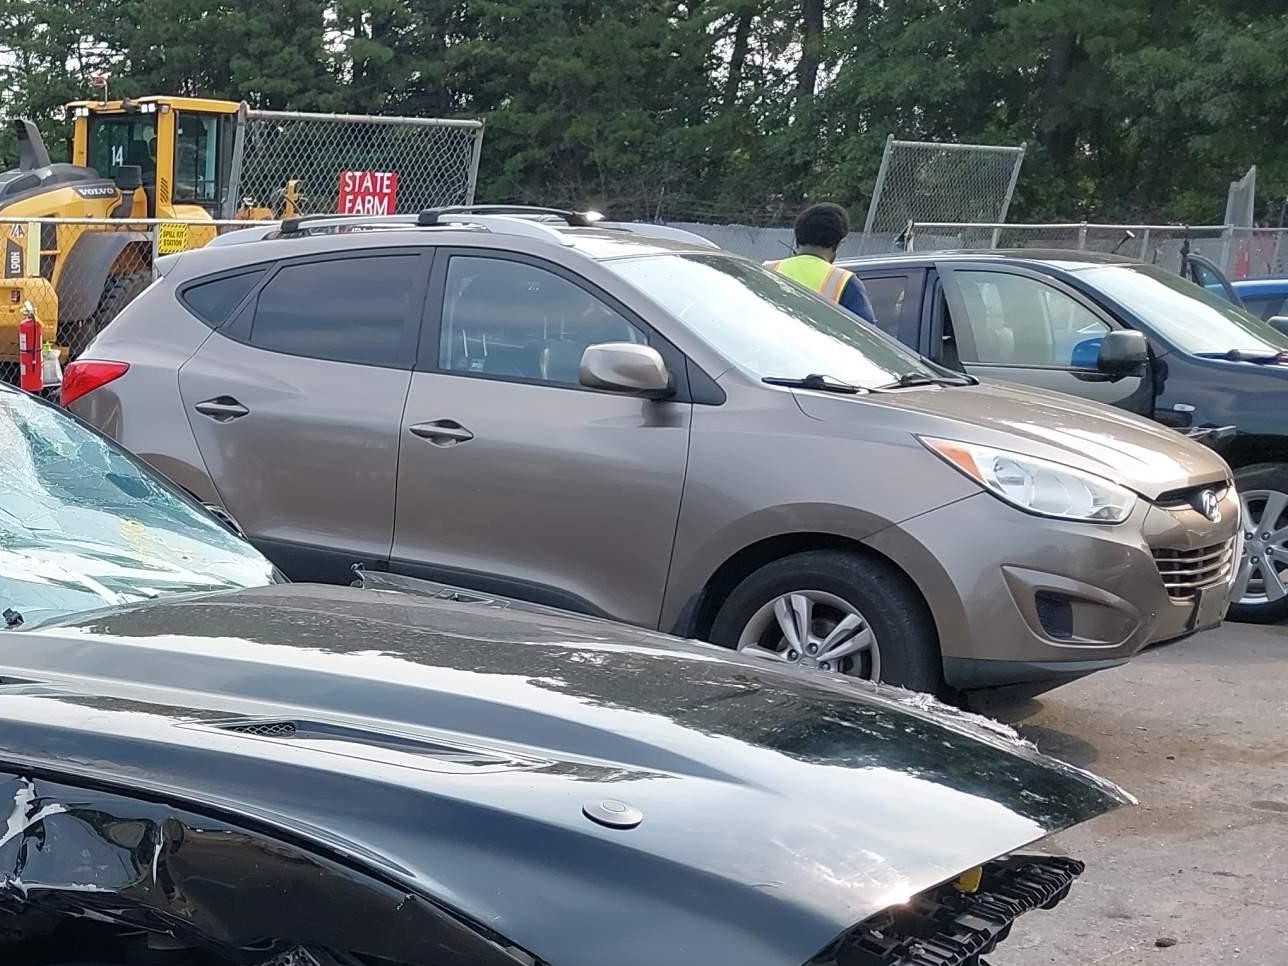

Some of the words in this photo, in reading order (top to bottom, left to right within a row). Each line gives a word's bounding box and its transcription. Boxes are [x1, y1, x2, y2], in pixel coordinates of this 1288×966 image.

[112, 145, 123, 167] 14
[78, 187, 114, 195] VOLVO
[344, 171, 392, 193] STATE
[344, 194, 389, 215] FARM
[163, 239, 183, 247] STATION
